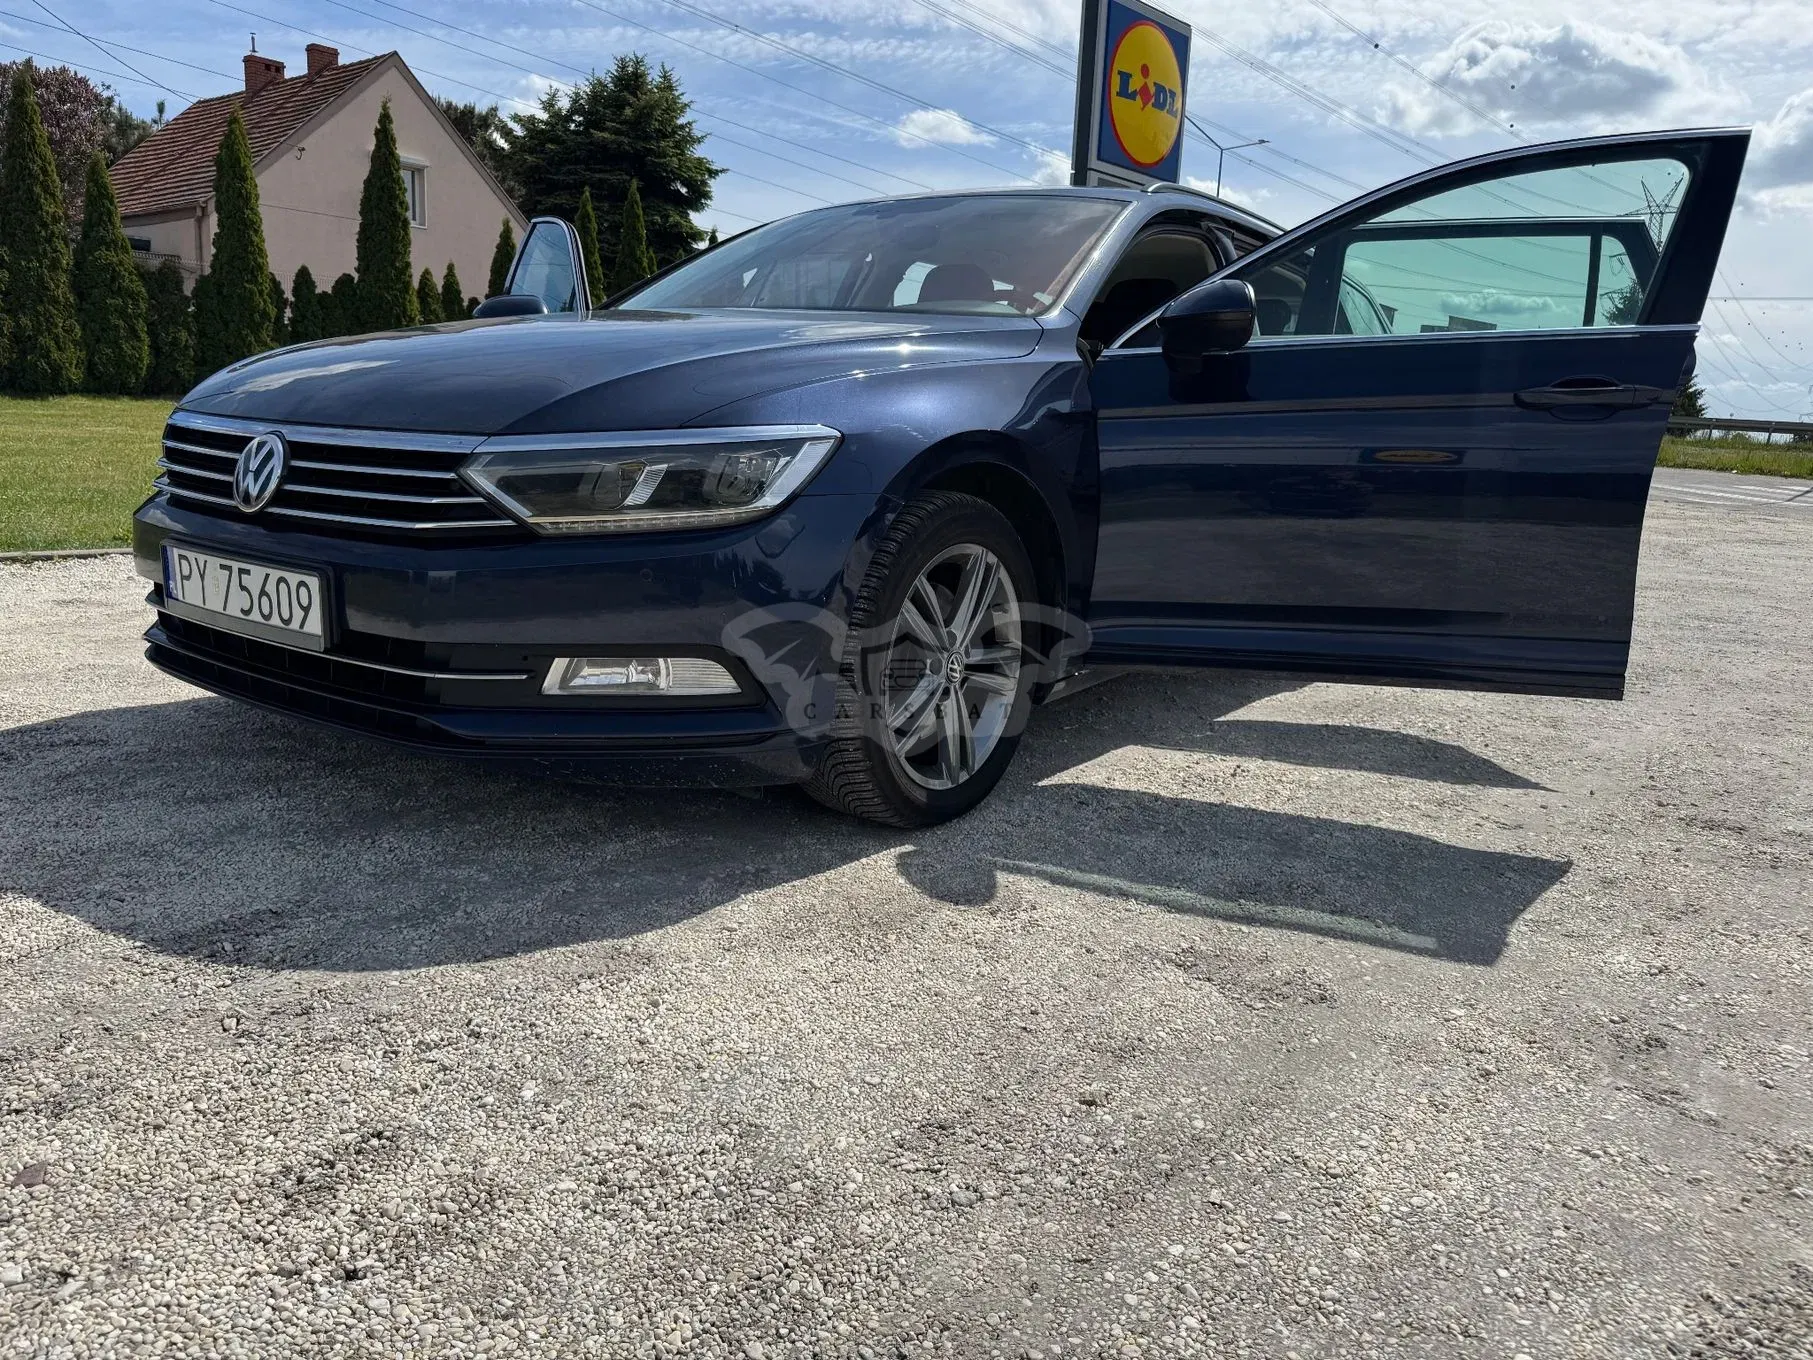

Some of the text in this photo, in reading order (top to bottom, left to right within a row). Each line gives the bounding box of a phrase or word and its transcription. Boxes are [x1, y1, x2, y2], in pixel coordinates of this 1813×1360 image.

[235, 434, 284, 510] VW
[178, 553, 313, 630] PY 75609
